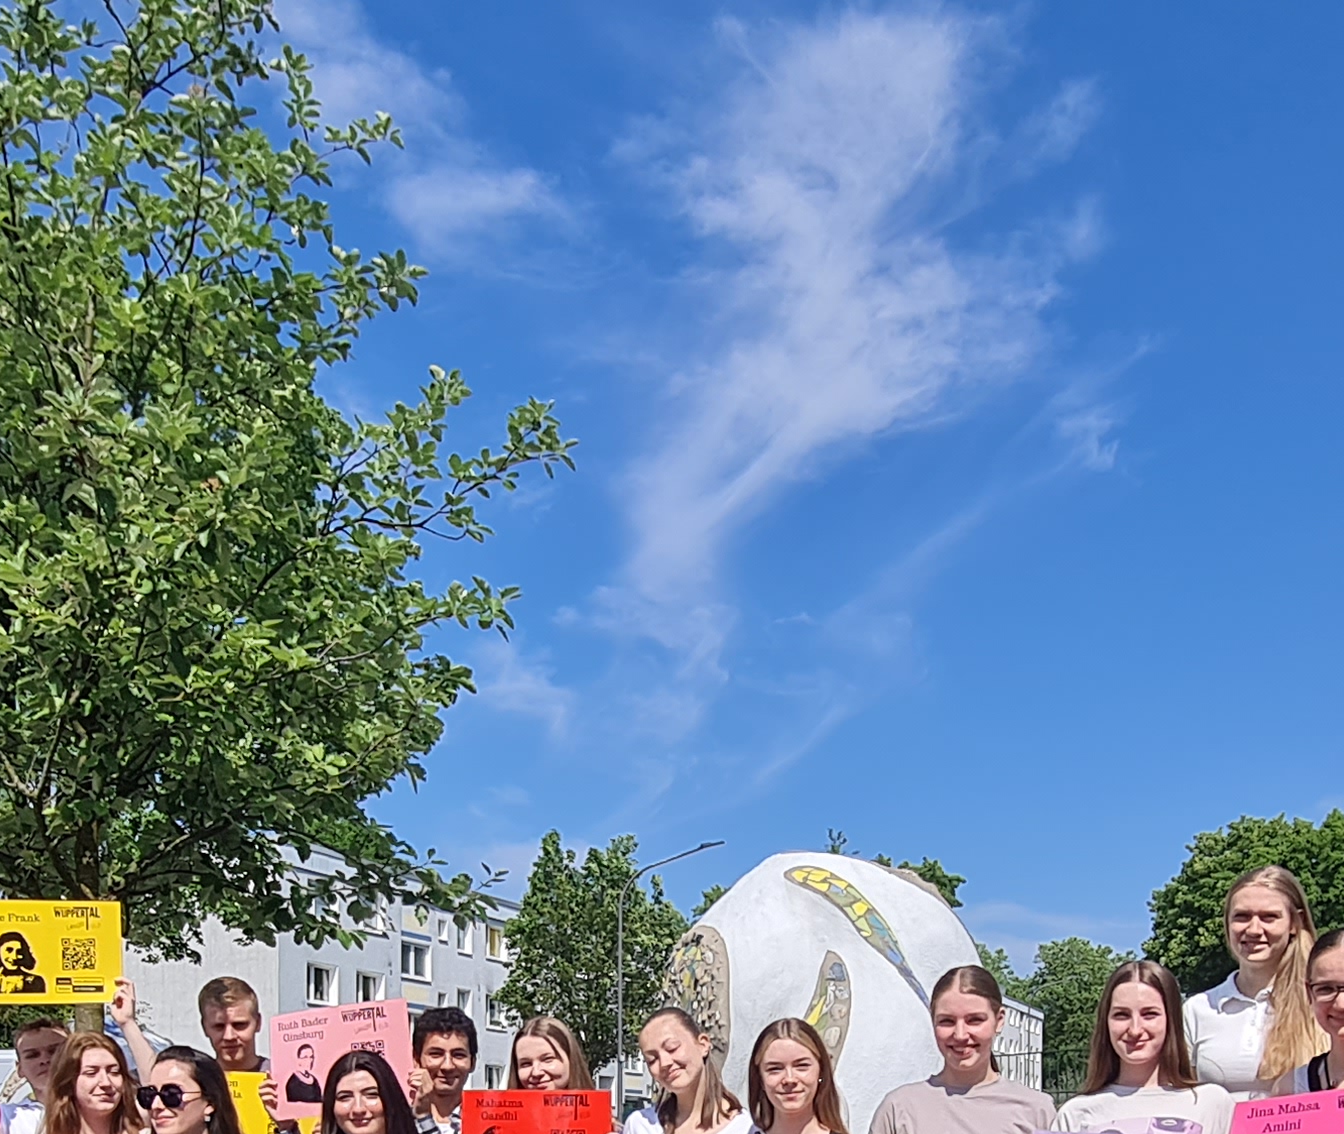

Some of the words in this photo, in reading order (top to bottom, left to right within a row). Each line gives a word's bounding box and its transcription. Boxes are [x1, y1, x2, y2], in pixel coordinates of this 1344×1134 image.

[8, 913, 41, 922] Frank
[53, 906, 101, 930] WUPPERTAL
[278, 1020, 298, 1032] Ruth
[301, 1017, 328, 1028] Bader
[341, 1006, 387, 1032] WUPPERTAL
[283, 1030, 324, 1044] Ginsburg
[476, 1098, 524, 1108] Mahatma
[544, 1094, 590, 1120] WUPPERTAL
[481, 1111, 518, 1121] Gandhi
[1247, 1106, 1274, 1120] Jina
[1278, 1102, 1320, 1115] Mahsa
[1262, 1120, 1302, 1134] Amini
